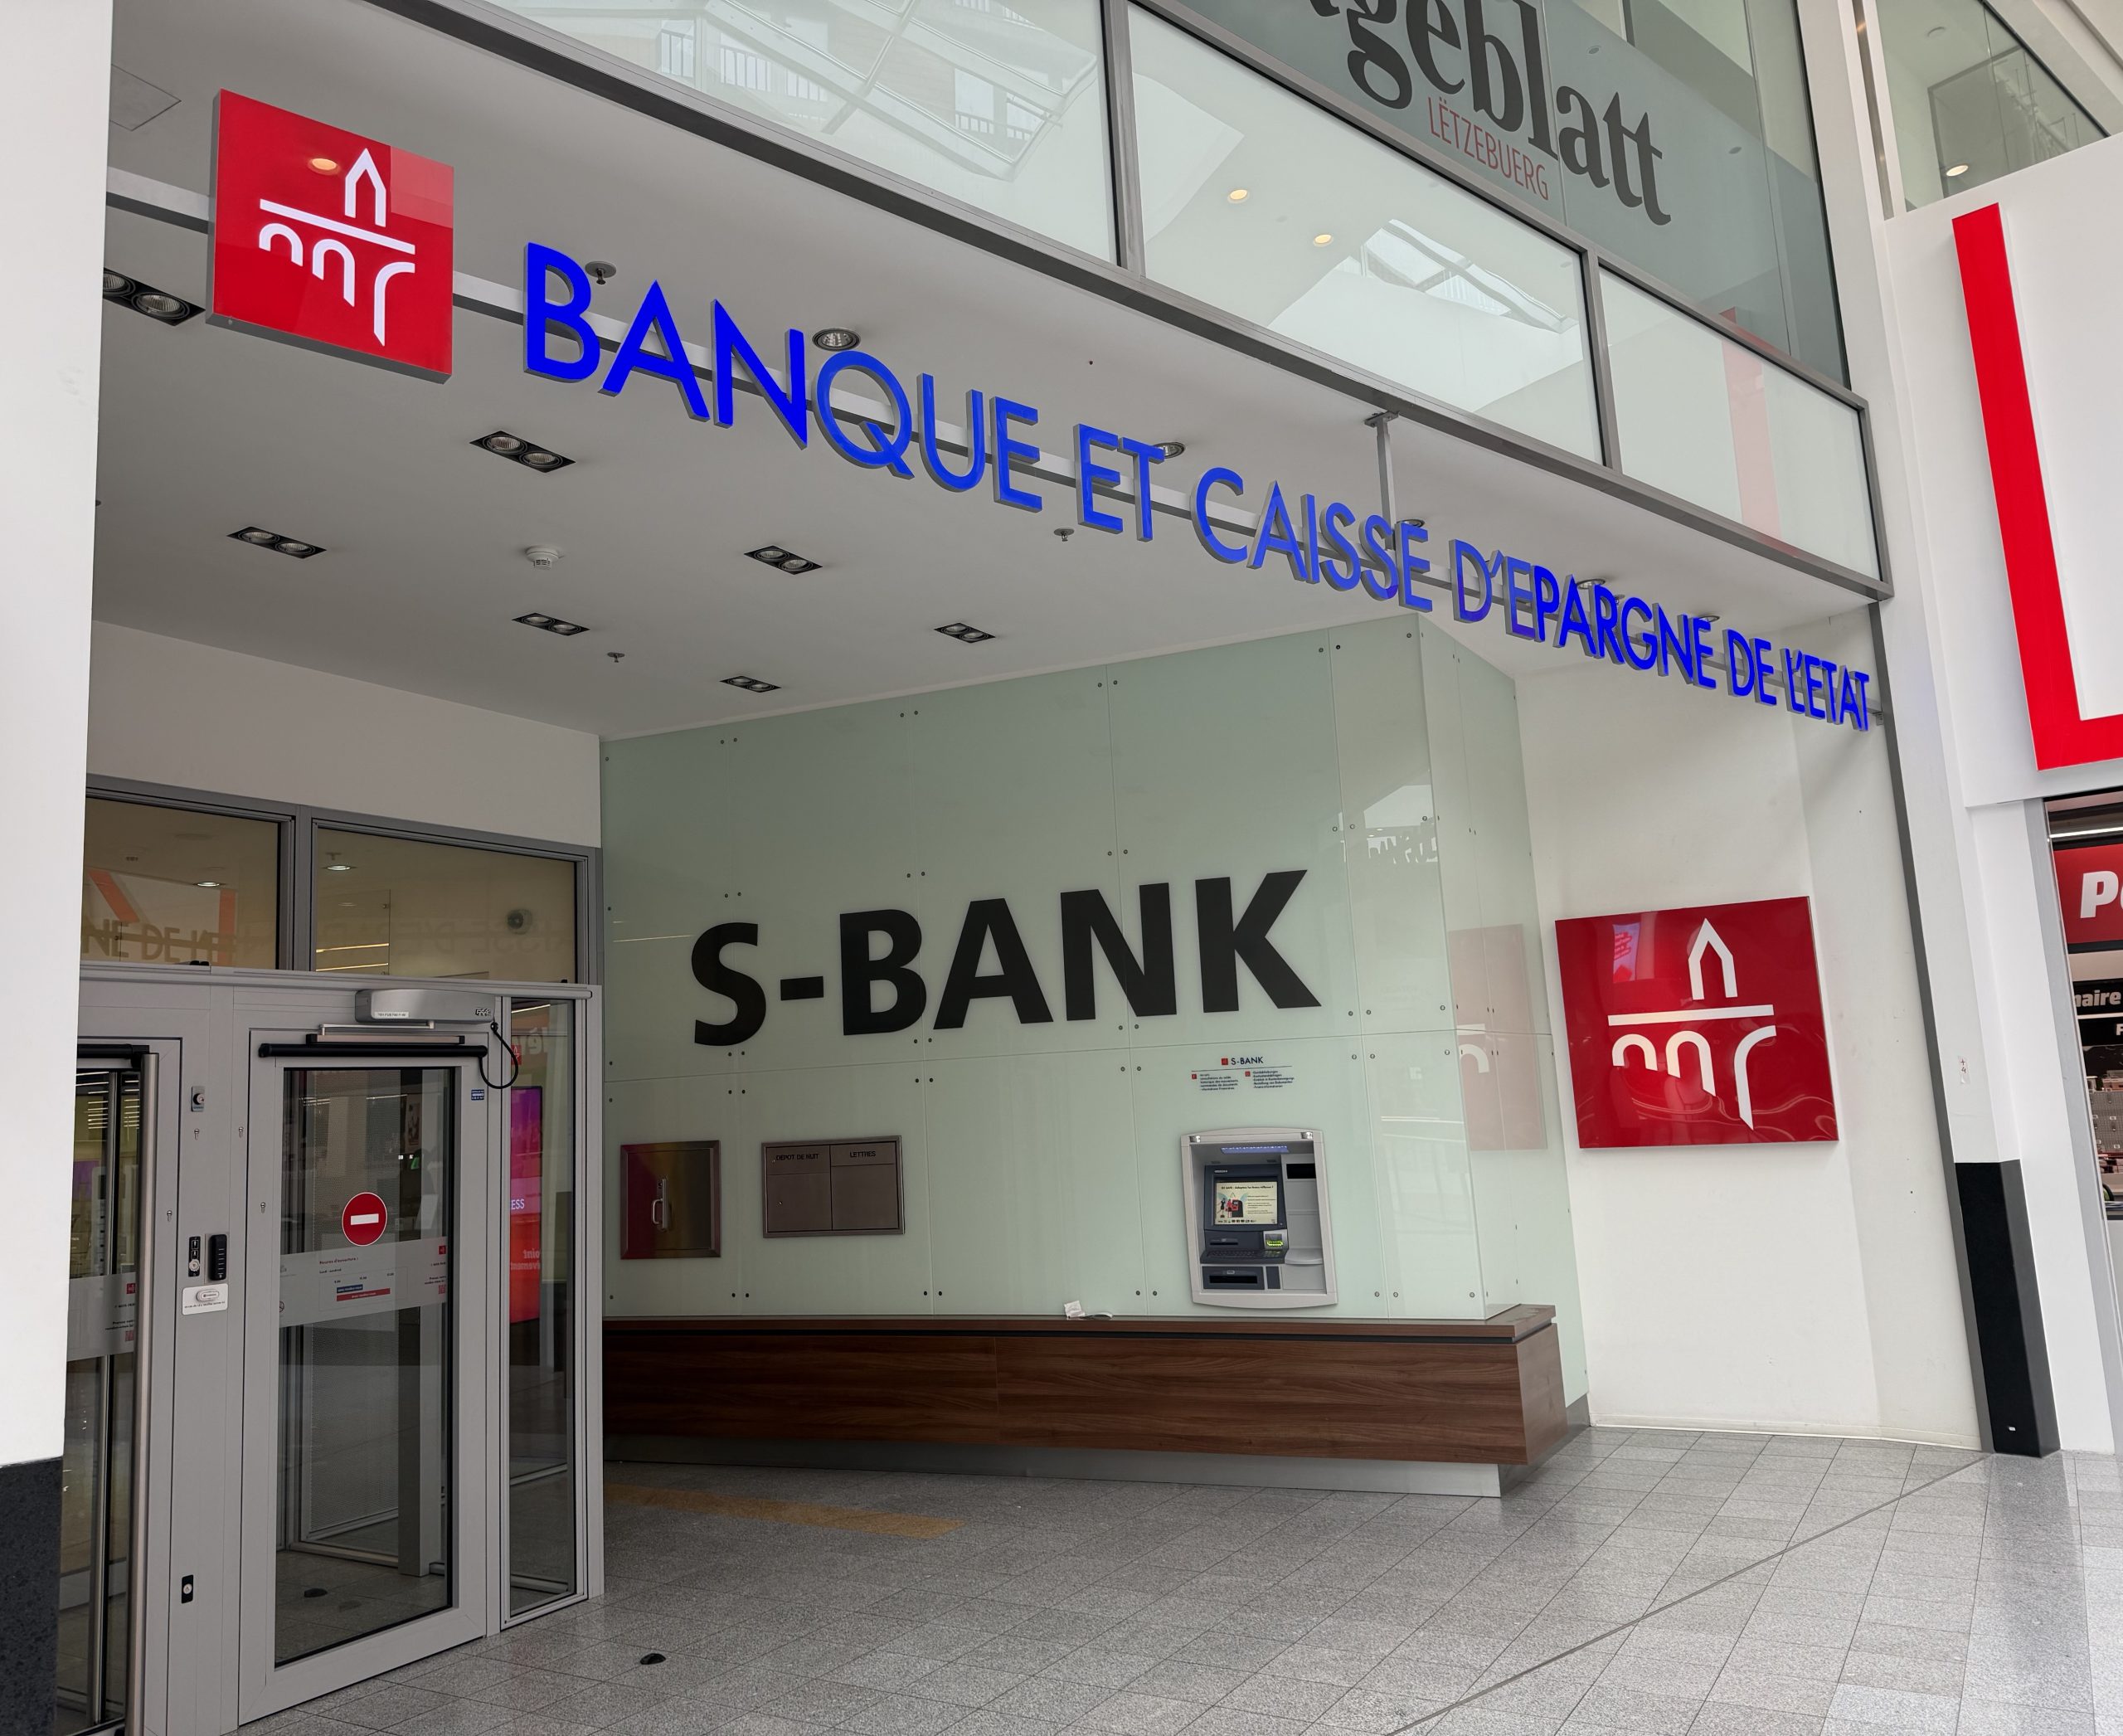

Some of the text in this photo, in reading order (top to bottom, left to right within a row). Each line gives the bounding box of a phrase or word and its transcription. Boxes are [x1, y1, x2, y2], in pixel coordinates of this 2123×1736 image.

[1309, 0, 1671, 226] geblatt
[1428, 97, 1548, 201] LËTZEBUERG
[523, 241, 1869, 732] BANQUE ET CAISSE D'EPARGNE DE L'ETAT
[691, 868, 1322, 1046] S-BANK
[1231, 1056, 1264, 1066] S-BANK
